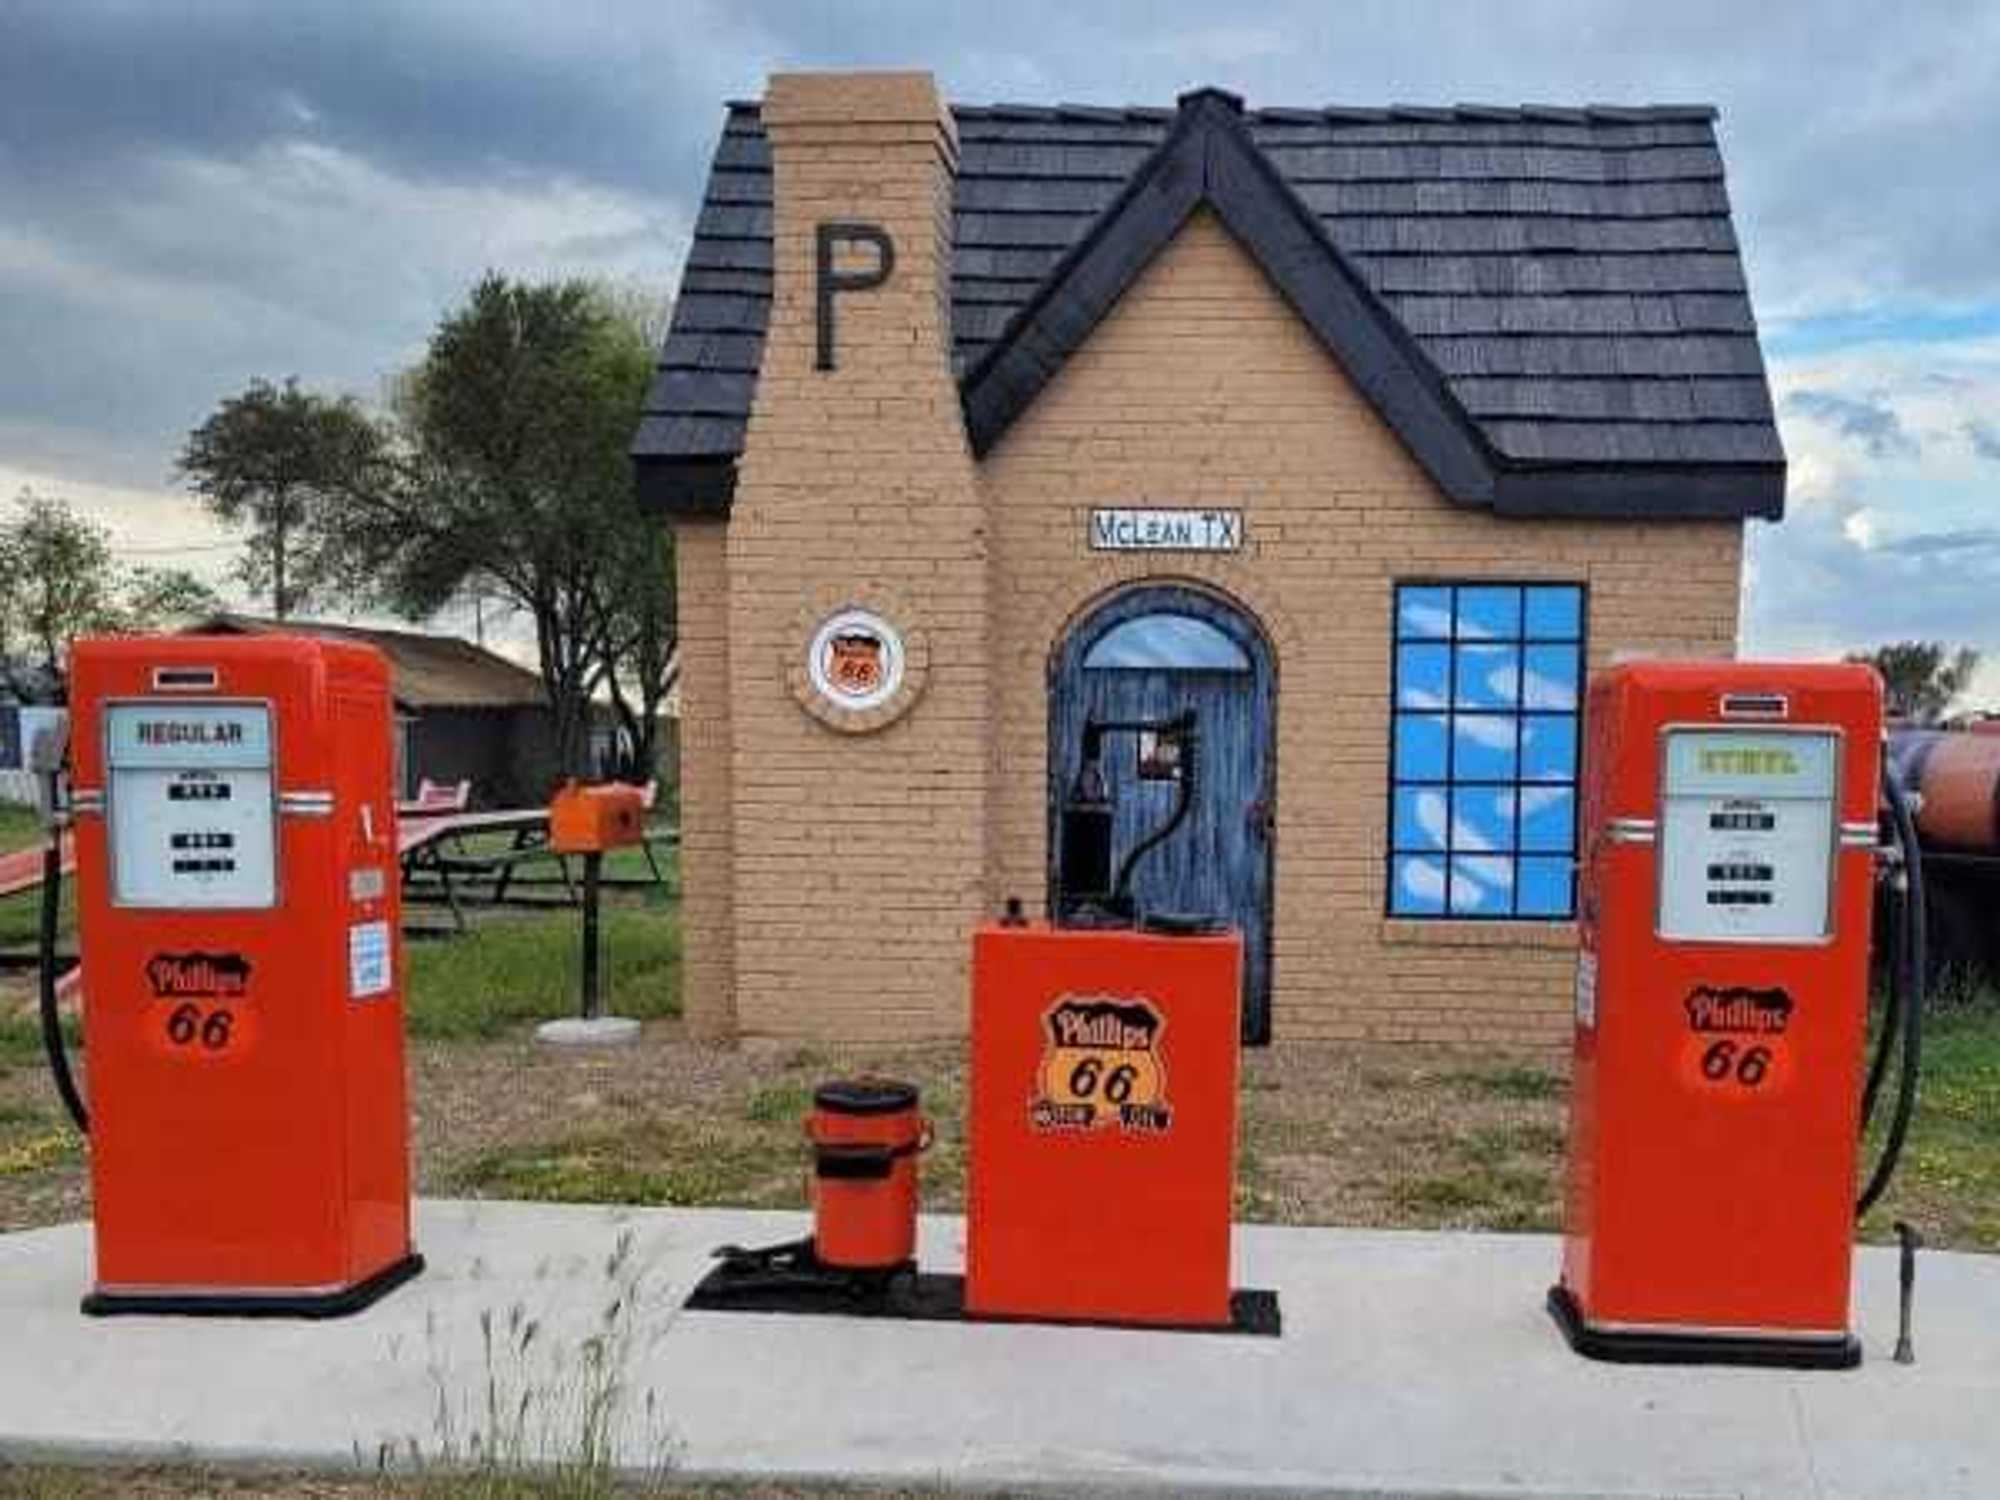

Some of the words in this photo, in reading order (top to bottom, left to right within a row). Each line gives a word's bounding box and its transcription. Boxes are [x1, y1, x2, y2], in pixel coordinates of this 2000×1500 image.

[816, 223, 895, 372] P
[1202, 511, 1234, 548] TX
[138, 723, 241, 743] REGULAR
[167, 1003, 234, 1051] 66
[1056, 1010, 1149, 1055] Phillips
[1690, 993, 1785, 1034] Phillips
[1070, 1058, 1138, 1104] 66
[1702, 1041, 1772, 1085] 66
